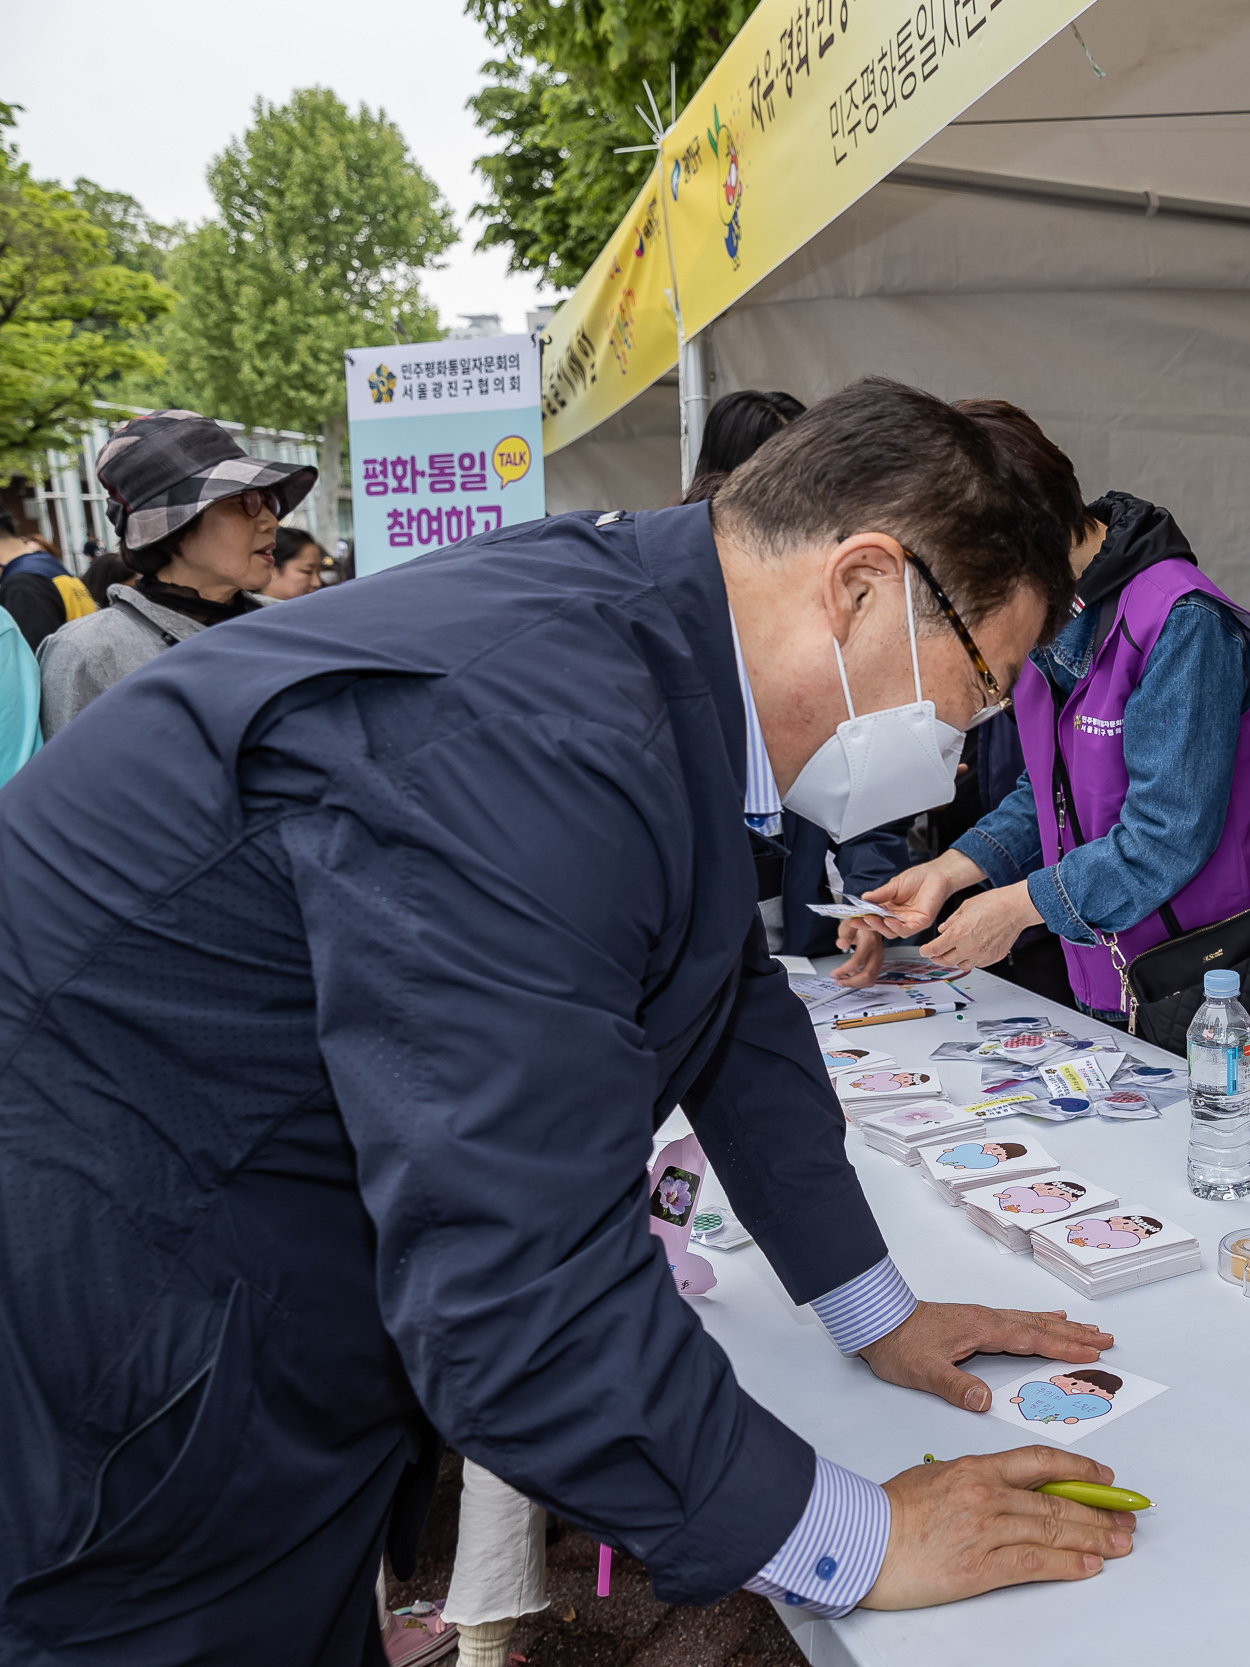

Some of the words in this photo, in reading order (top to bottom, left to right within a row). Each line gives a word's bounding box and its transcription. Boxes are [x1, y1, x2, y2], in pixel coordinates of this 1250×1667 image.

[401, 352, 521, 381] 민주평화통일자문회의
[362, 451, 488, 497] 평화·통일
[498, 450, 528, 468] TALK
[386, 504, 503, 547] 참여하고
